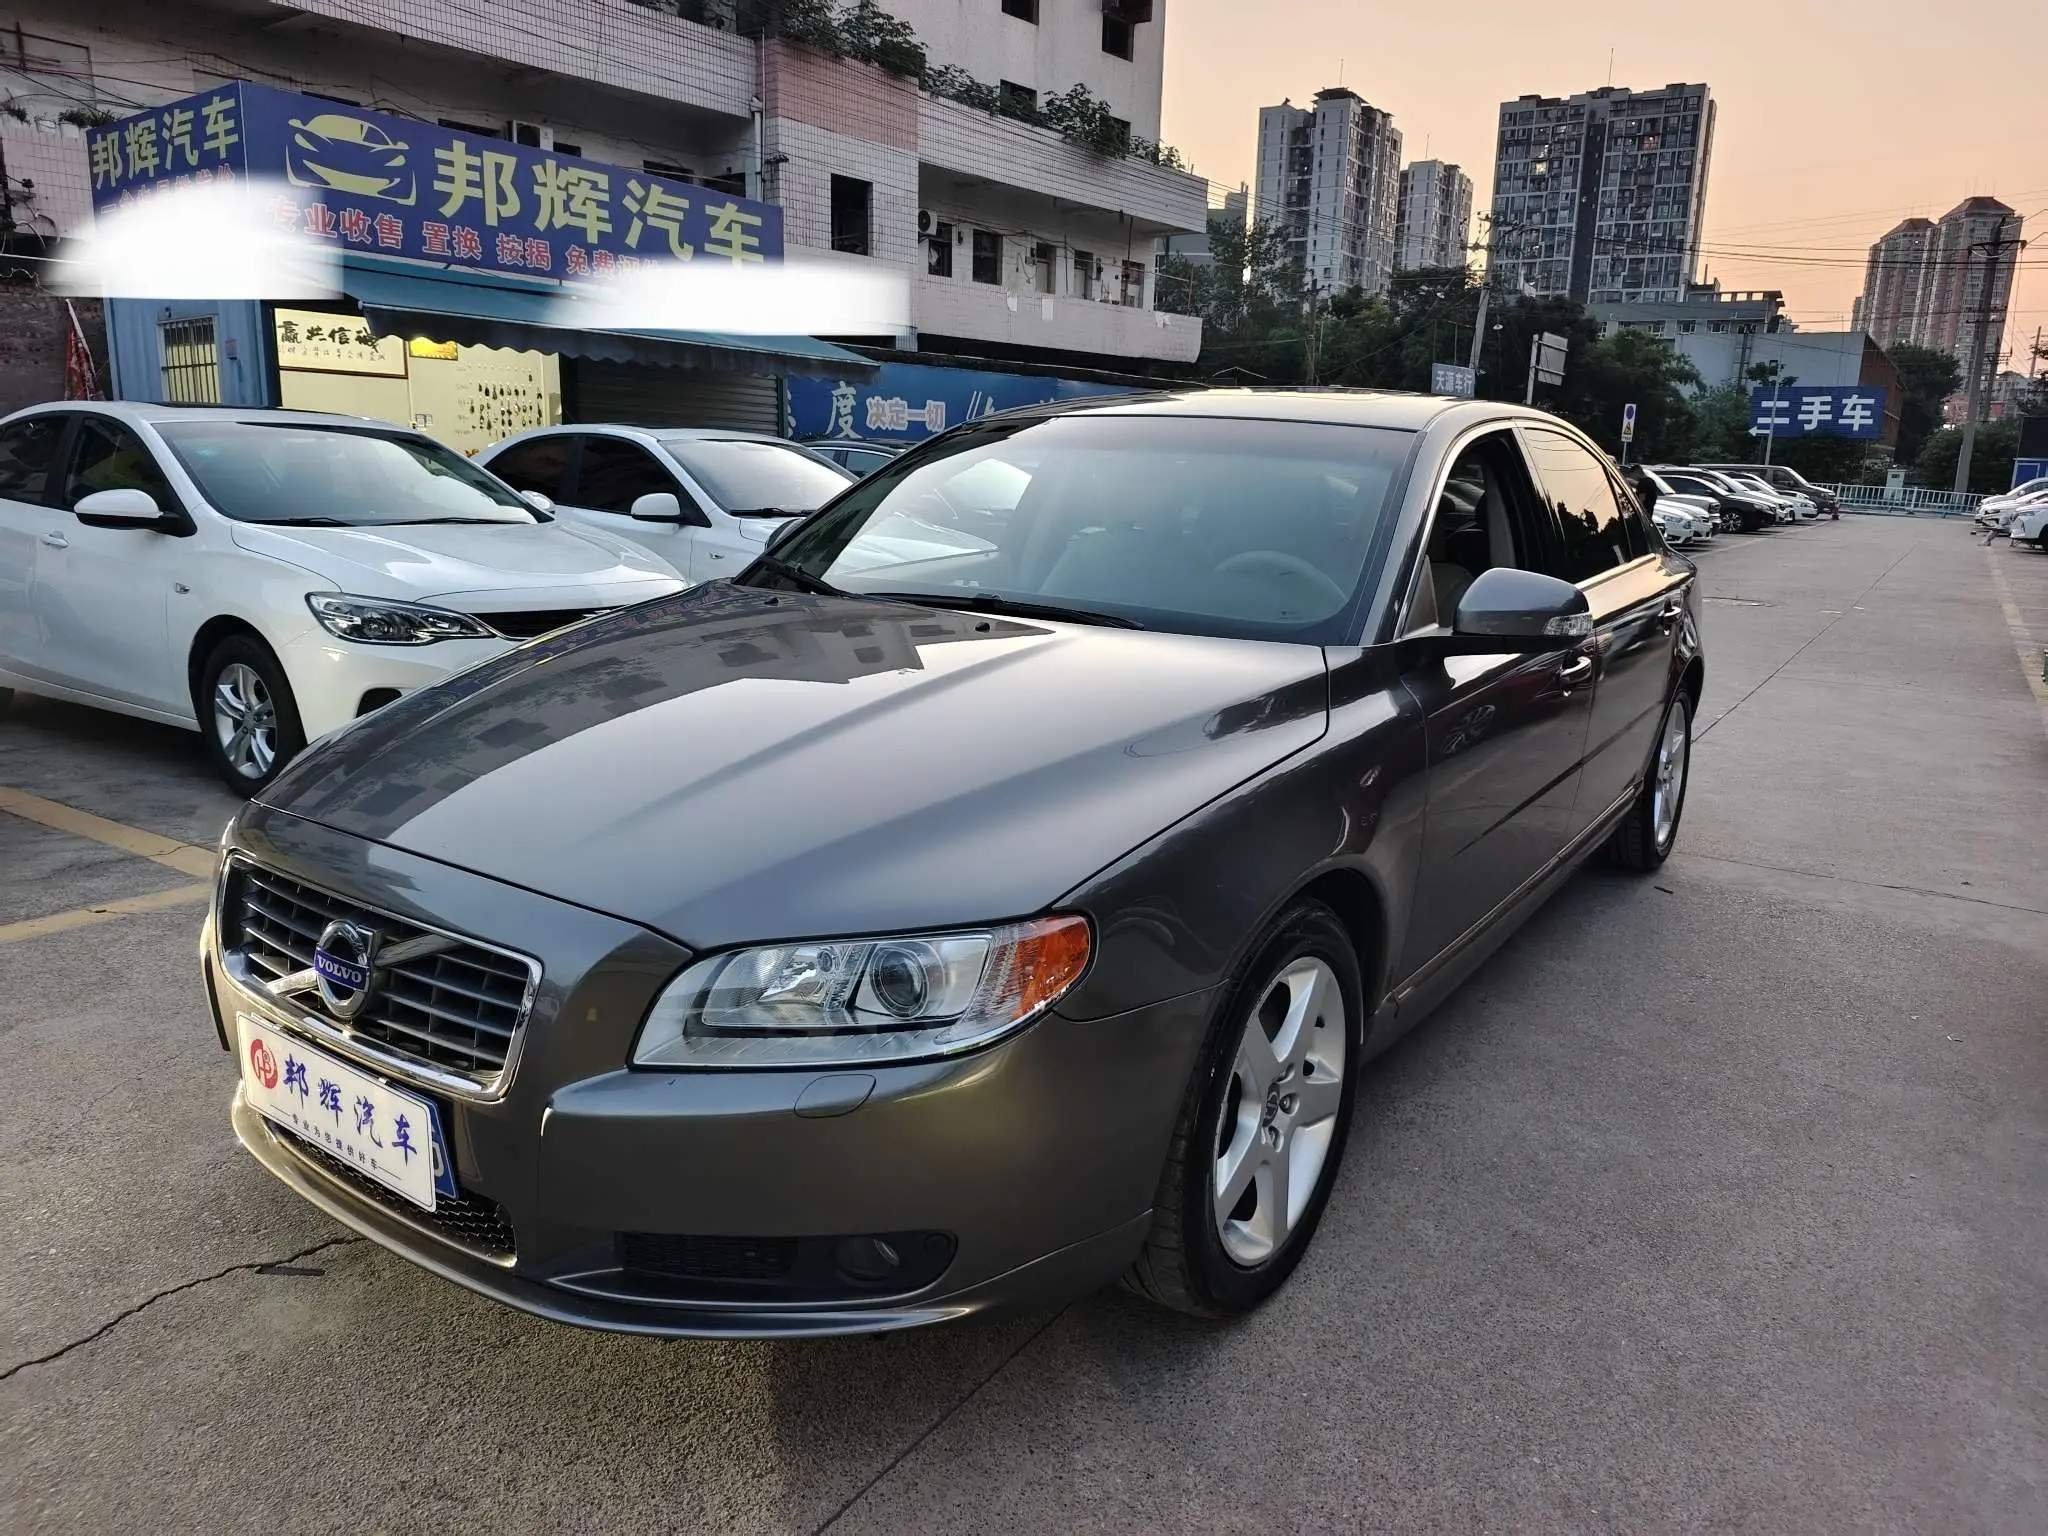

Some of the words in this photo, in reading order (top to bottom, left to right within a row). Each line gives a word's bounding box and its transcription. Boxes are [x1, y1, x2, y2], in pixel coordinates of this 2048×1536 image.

[91, 96, 239, 190] 邦辉汽车
[267, 194, 403, 249] 专业收售
[422, 221, 482, 261] 置换
[496, 233, 552, 271] 按揭
[433, 139, 764, 269] 邦辉汽车
[1757, 394, 1875, 431] 二手车
[316, 956, 363, 984] VOLVO
[283, 1054, 417, 1166] 邦辉汽车
